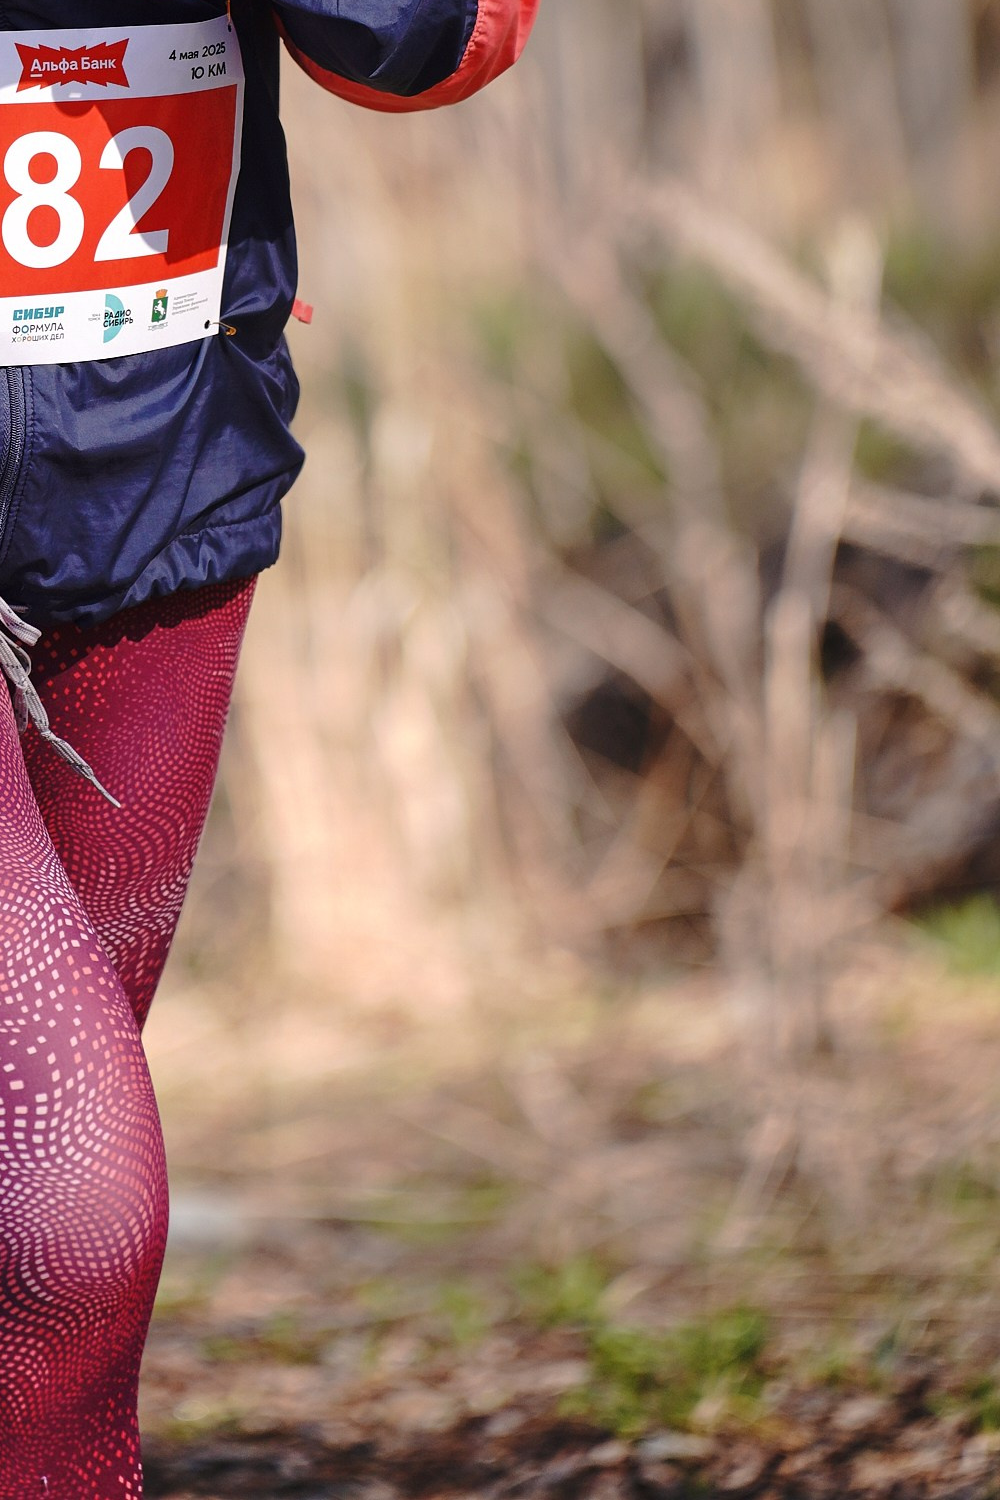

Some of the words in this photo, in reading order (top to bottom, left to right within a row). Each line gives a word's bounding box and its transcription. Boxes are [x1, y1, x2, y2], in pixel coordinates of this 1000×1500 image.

[168, 49, 177, 61] 4
[179, 49, 199, 61] мая
[202, 41, 226, 58] 2025
[30, 58, 78, 77] Альфа
[81, 57, 117, 70] Банк
[191, 65, 205, 80] 10
[208, 61, 227, 78] КМ
[13, 306, 65, 321] СИБУР
[104, 308, 132, 320] РАДИО
[12, 322, 65, 335] ФОРМУЛА
[103, 317, 134, 328] СИБИРЬ
[12, 334, 49, 343] ХОРОШИХ
[50, 332, 65, 341] ДЕЛ
